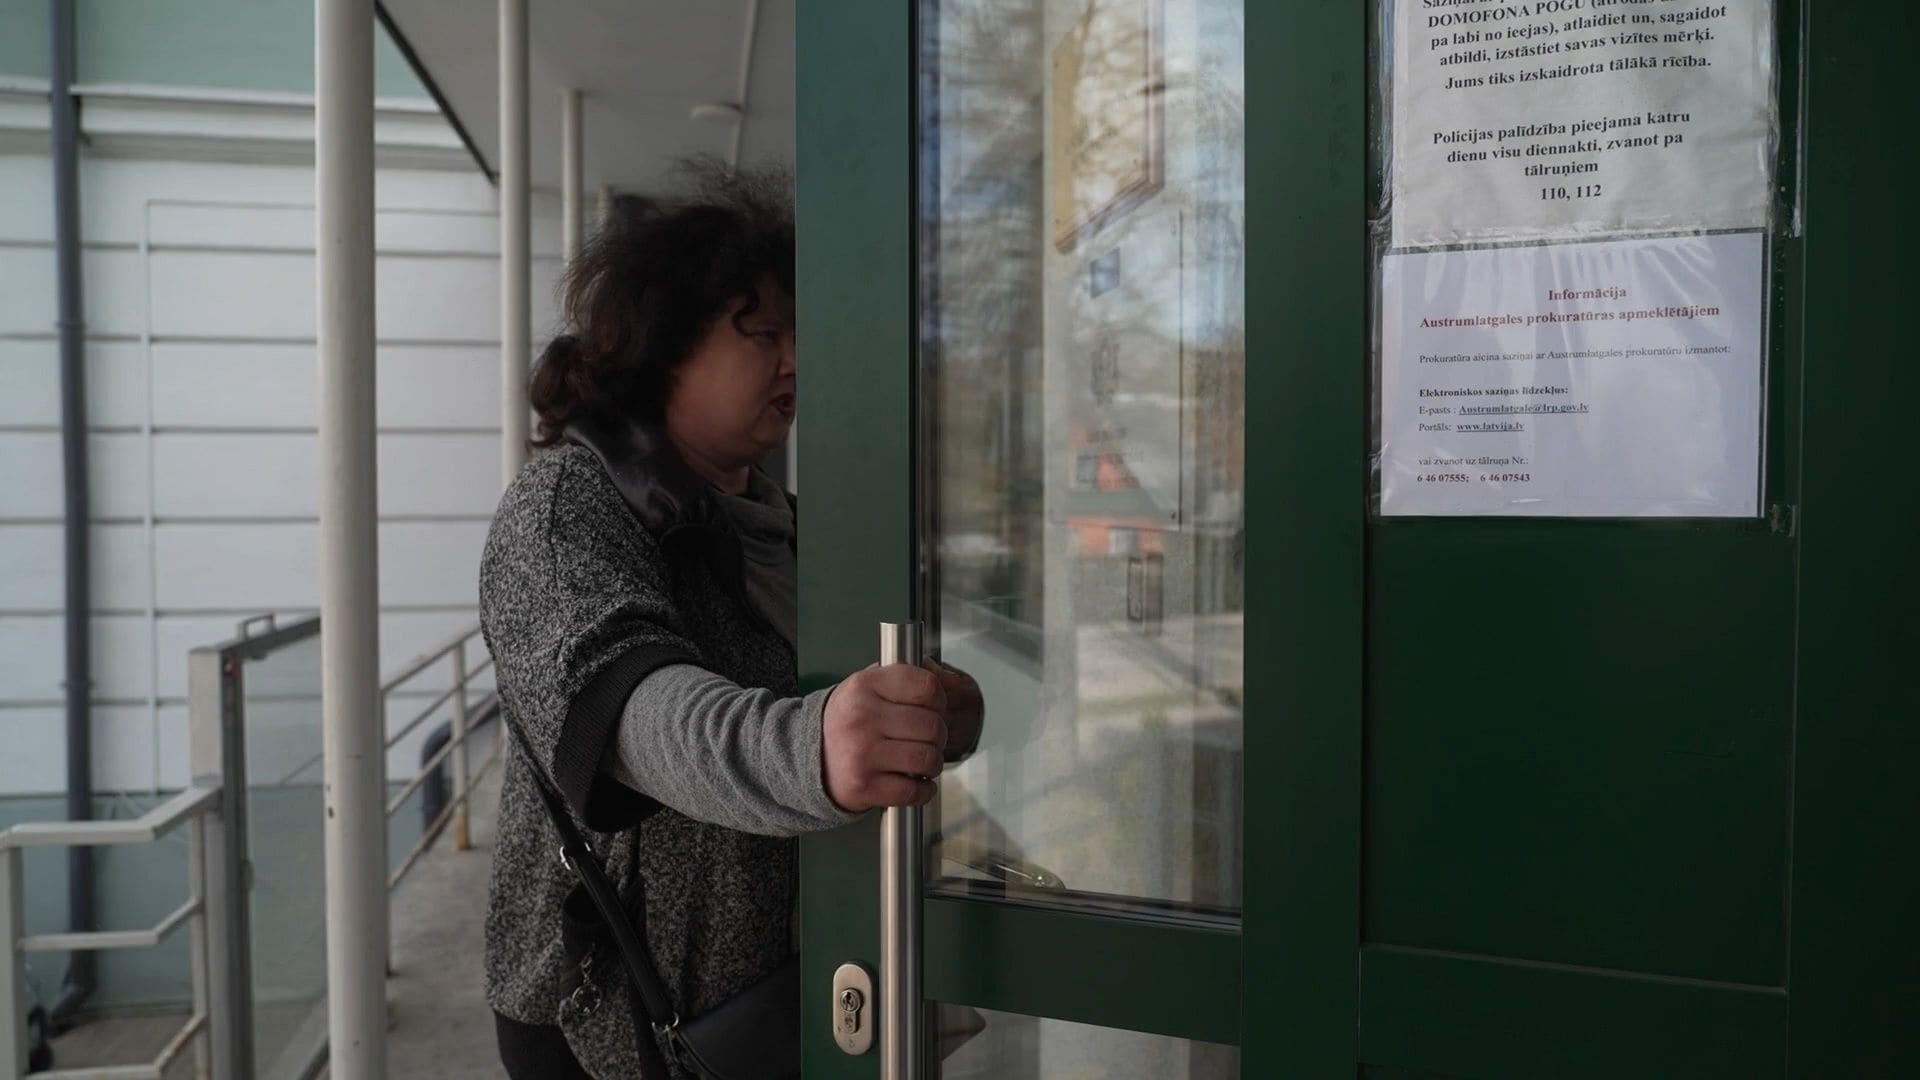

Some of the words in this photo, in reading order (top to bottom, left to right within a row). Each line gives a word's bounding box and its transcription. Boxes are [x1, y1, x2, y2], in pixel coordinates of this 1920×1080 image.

[1428, 5, 1530, 28] DOMOFONA
[1535, 0, 1585, 14] POGU
[1431, 37, 1448, 50] pa
[1453, 31, 1480, 45] labi
[1485, 31, 1502, 41] no
[1507, 22, 1559, 39] ieejas),
[1563, 14, 1626, 31] atlaidiet
[1631, 14, 1655, 25] un,
[1660, 5, 1727, 25] sagaidot
[1440, 51, 1491, 66] atbildi,
[1495, 42, 1560, 60] izstāstiet
[1564, 36, 1606, 51] savas
[1611, 32, 1658, 45] vizītes
[1663, 28, 1714, 43] mērķi.
[1445, 77, 1484, 90] Jums
[1488, 73, 1515, 85] tiks
[1519, 63, 1604, 82] izskaidrota
[1609, 56, 1657, 71] tālākā
[1662, 55, 1711, 68] rīcība.
[1433, 128, 1494, 144] Policijas
[1498, 122, 1566, 142] palīdzība
[1571, 117, 1642, 136] pieejama
[1647, 111, 1691, 125] katru
[1447, 150, 1487, 163] dienu
[1492, 146, 1521, 160] visu
[1526, 139, 1602, 157] diennakti,
[1607, 134, 1658, 150] zvanot
[1664, 134, 1683, 147] pa
[1524, 161, 1599, 177] tālruņiem
[1541, 187, 1570, 201] 110,
[1576, 185, 1602, 199] 112
[1548, 286, 1627, 301] Informācija
[1419, 313, 1523, 328] Austrumlatgales
[1527, 310, 1615, 326] prokuratūras
[1619, 305, 1720, 322] apmeklētājiem
[1419, 353, 1471, 364] Prokuratūra
[1473, 352, 1500, 362] aicina
[1535, 352, 1546, 360] ar
[1419, 387, 1483, 398] Elektroniskos
[1419, 405, 1451, 416] E-pasts
[1456, 421, 1525, 433] www.latvija.lv
[1418, 457, 1431, 466] vai
[1434, 457, 1463, 466] zvanot
[1465, 458, 1475, 466] uz
[1425, 474, 1437, 483] 46
[1438, 474, 1470, 484] 07555;
[1489, 473, 1501, 482] 46
[1502, 473, 1531, 483] 07543
